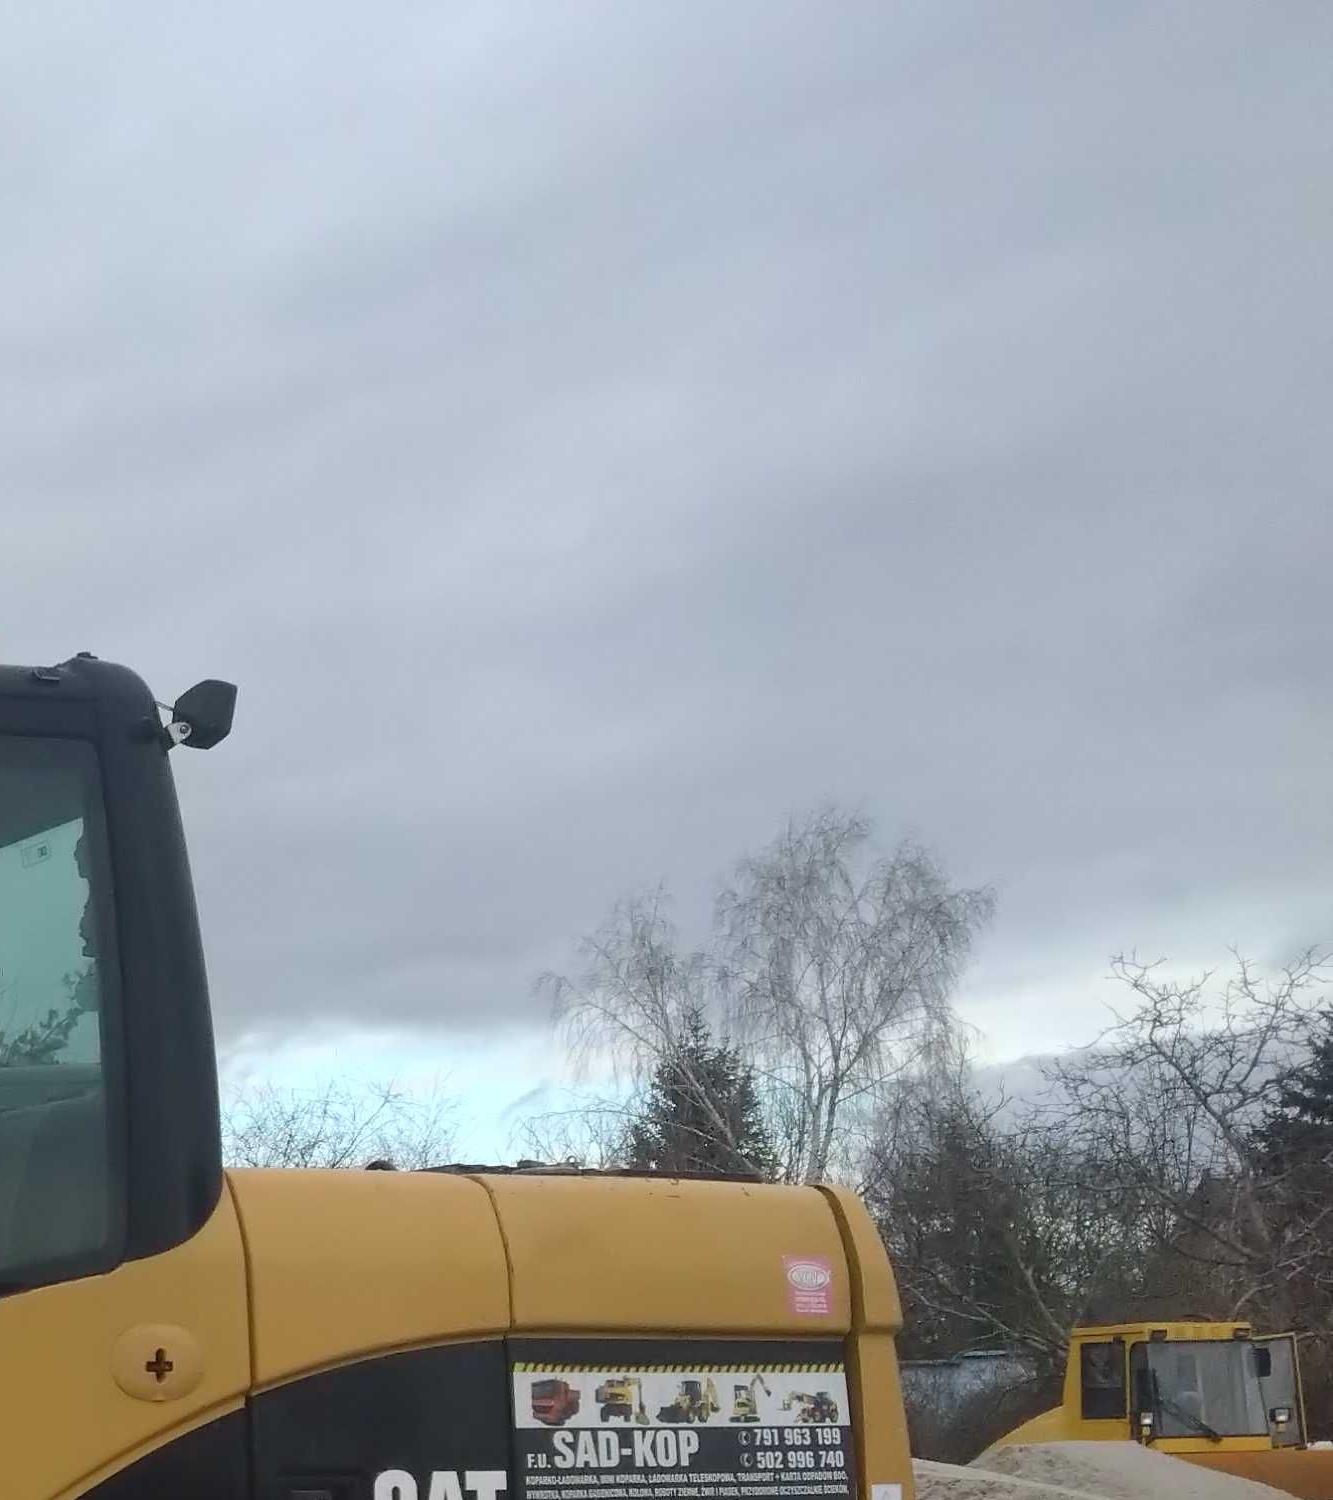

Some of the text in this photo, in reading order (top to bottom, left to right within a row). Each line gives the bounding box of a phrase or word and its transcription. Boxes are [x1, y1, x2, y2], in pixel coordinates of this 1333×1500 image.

[754, 1427, 841, 1446] 791 963 199
[527, 1430, 700, 1469] F.U. SAD-KOP
[757, 1450, 844, 1469] 502 996 740
